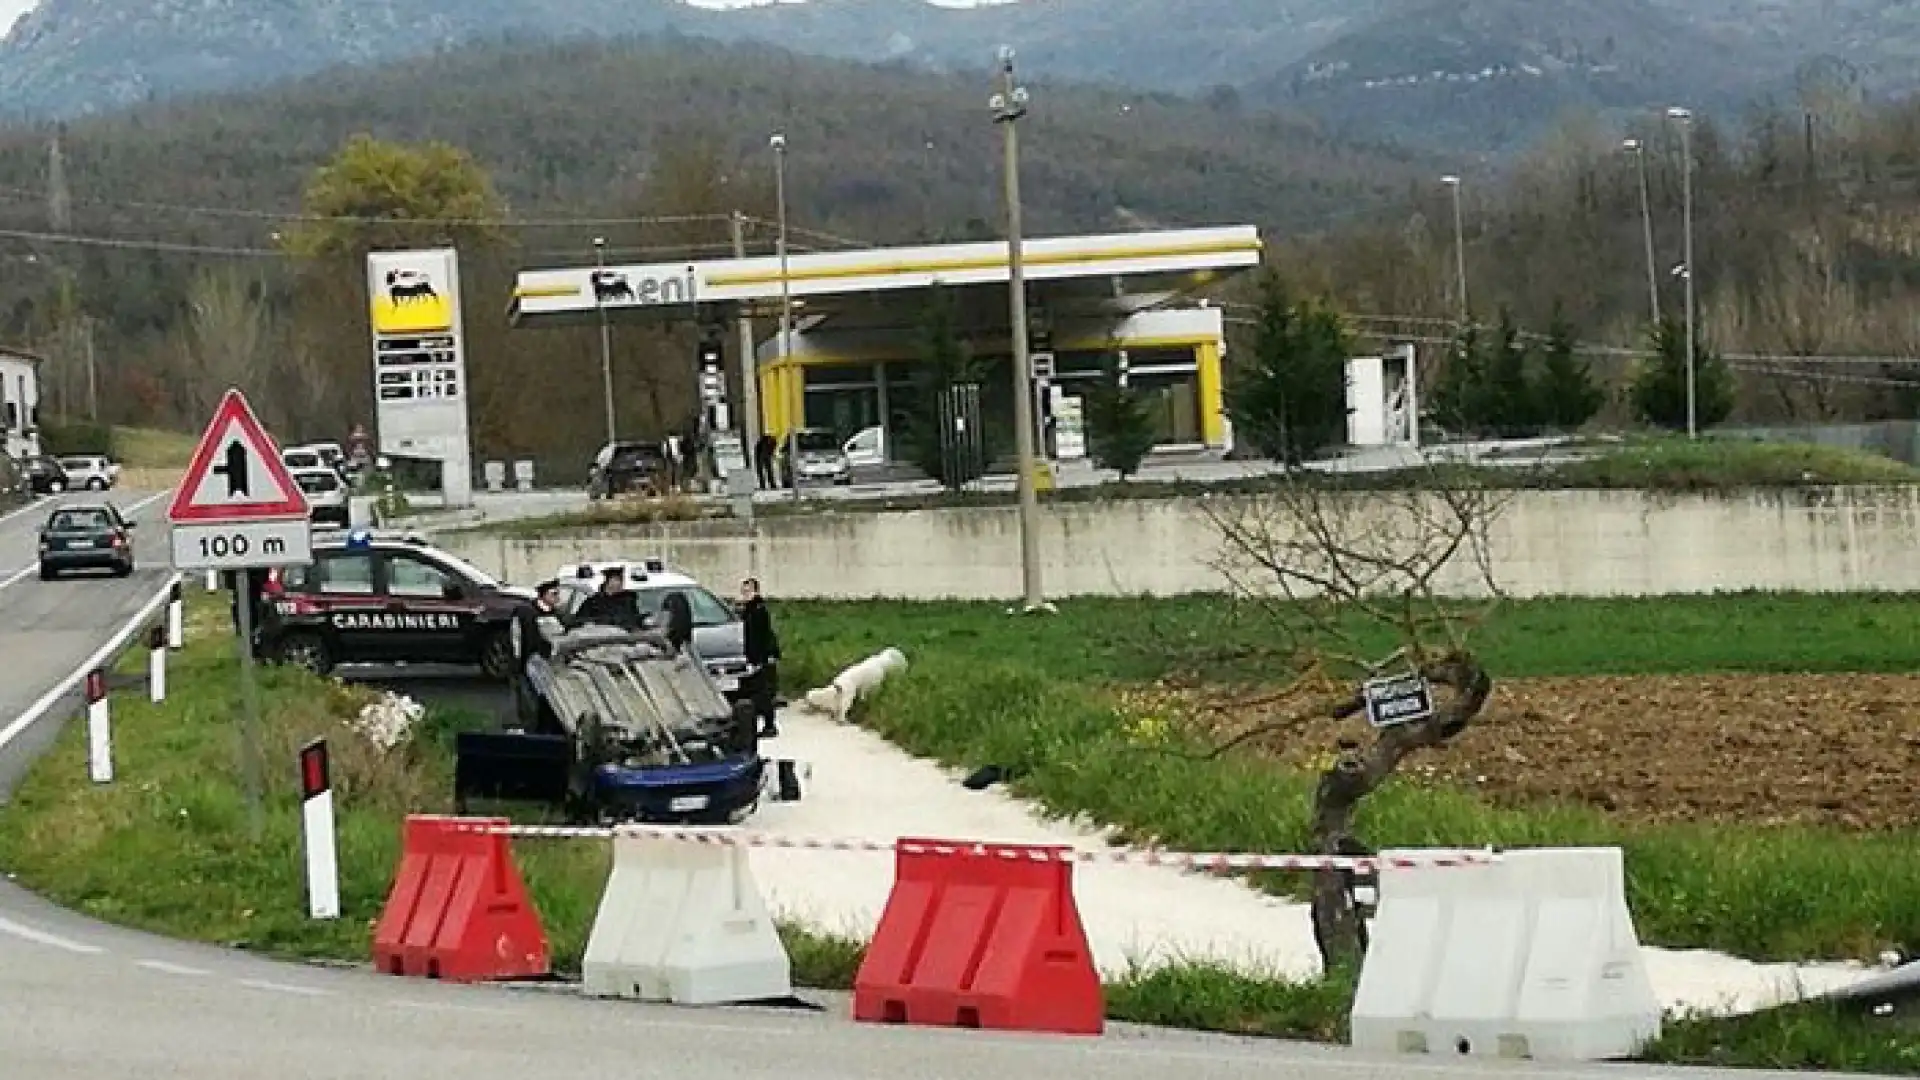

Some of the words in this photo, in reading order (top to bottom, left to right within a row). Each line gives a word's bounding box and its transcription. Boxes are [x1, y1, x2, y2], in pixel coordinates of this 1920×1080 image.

[639, 265, 696, 304] eni
[199, 534, 248, 557] 100
[262, 537, 285, 555] m
[331, 613, 459, 629] CARABINIERI
